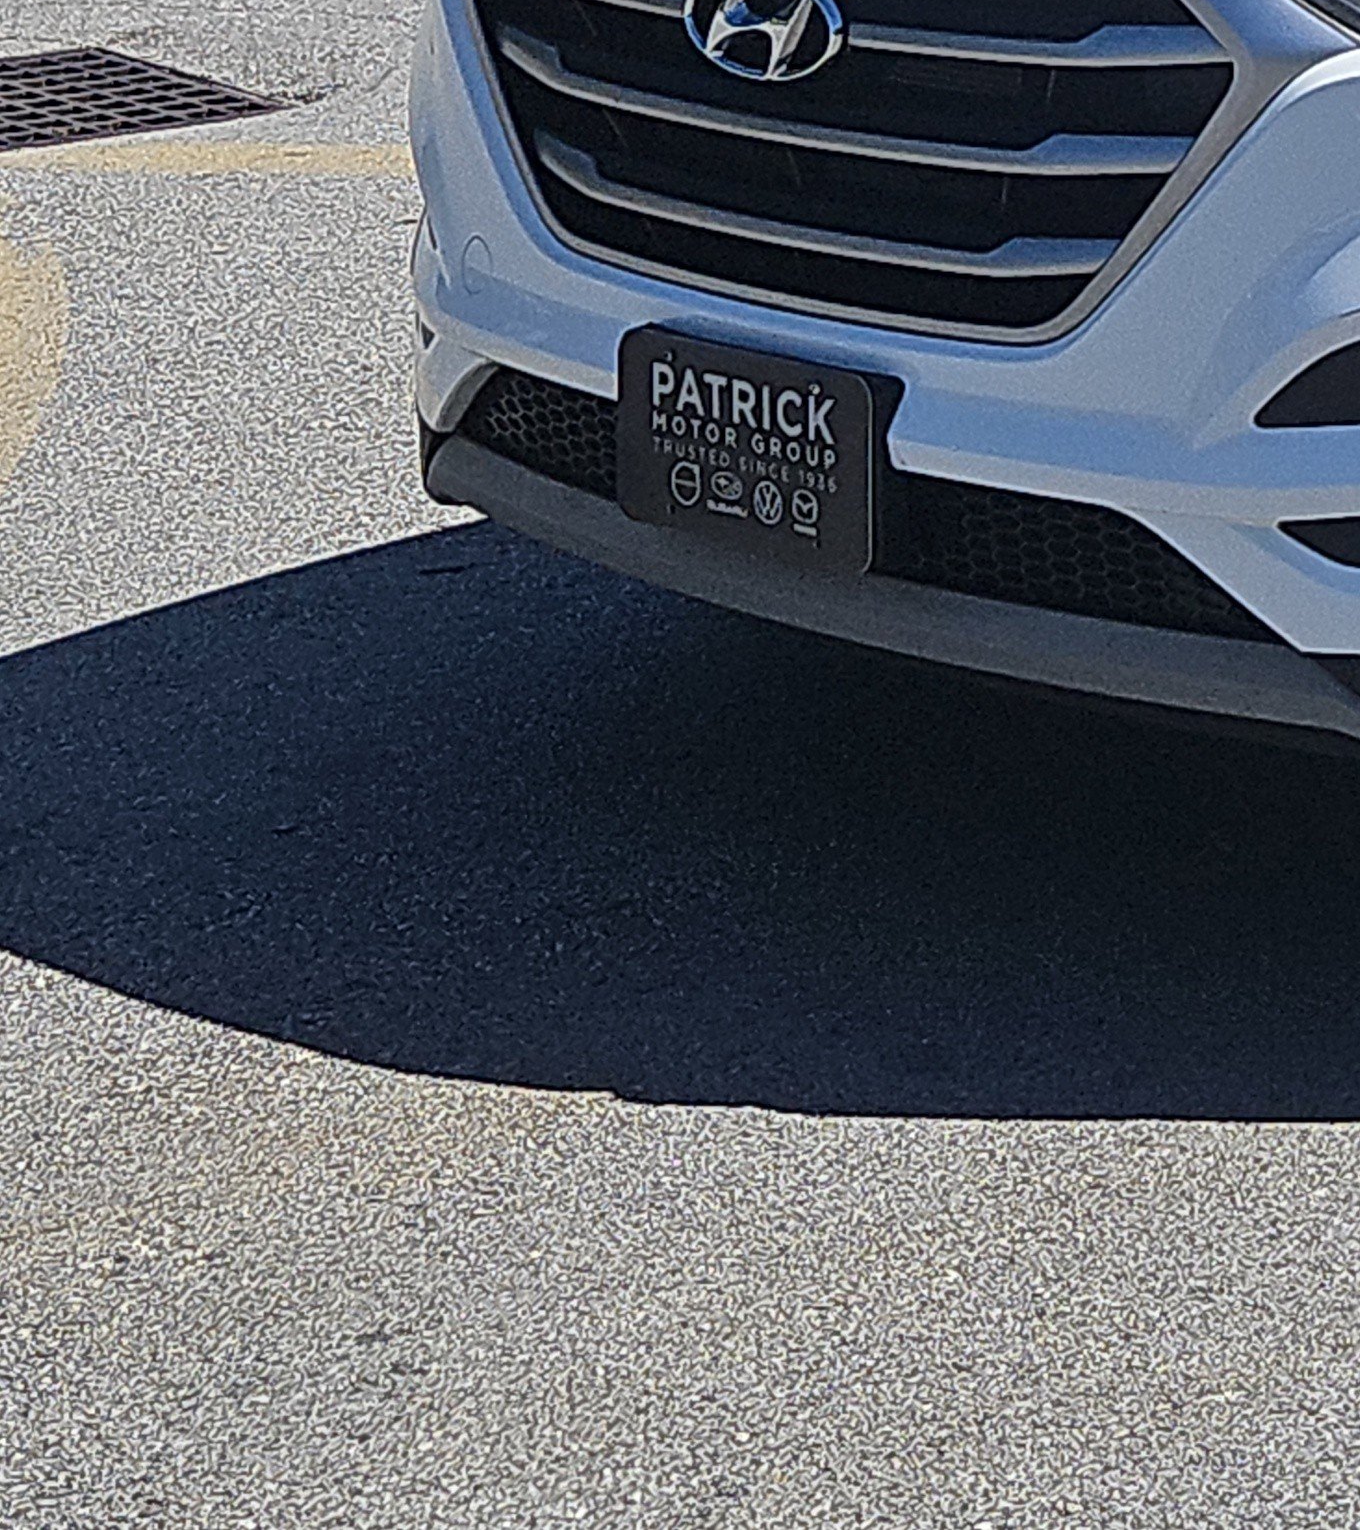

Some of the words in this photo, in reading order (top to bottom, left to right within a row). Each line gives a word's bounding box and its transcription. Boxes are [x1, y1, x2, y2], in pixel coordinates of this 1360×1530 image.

[651, 361, 837, 446] PATRICK
[651, 410, 738, 449] MOTOR
[751, 432, 836, 470] GROUP
[652, 435, 730, 468] TRUSTED
[739, 456, 790, 483] SINCE
